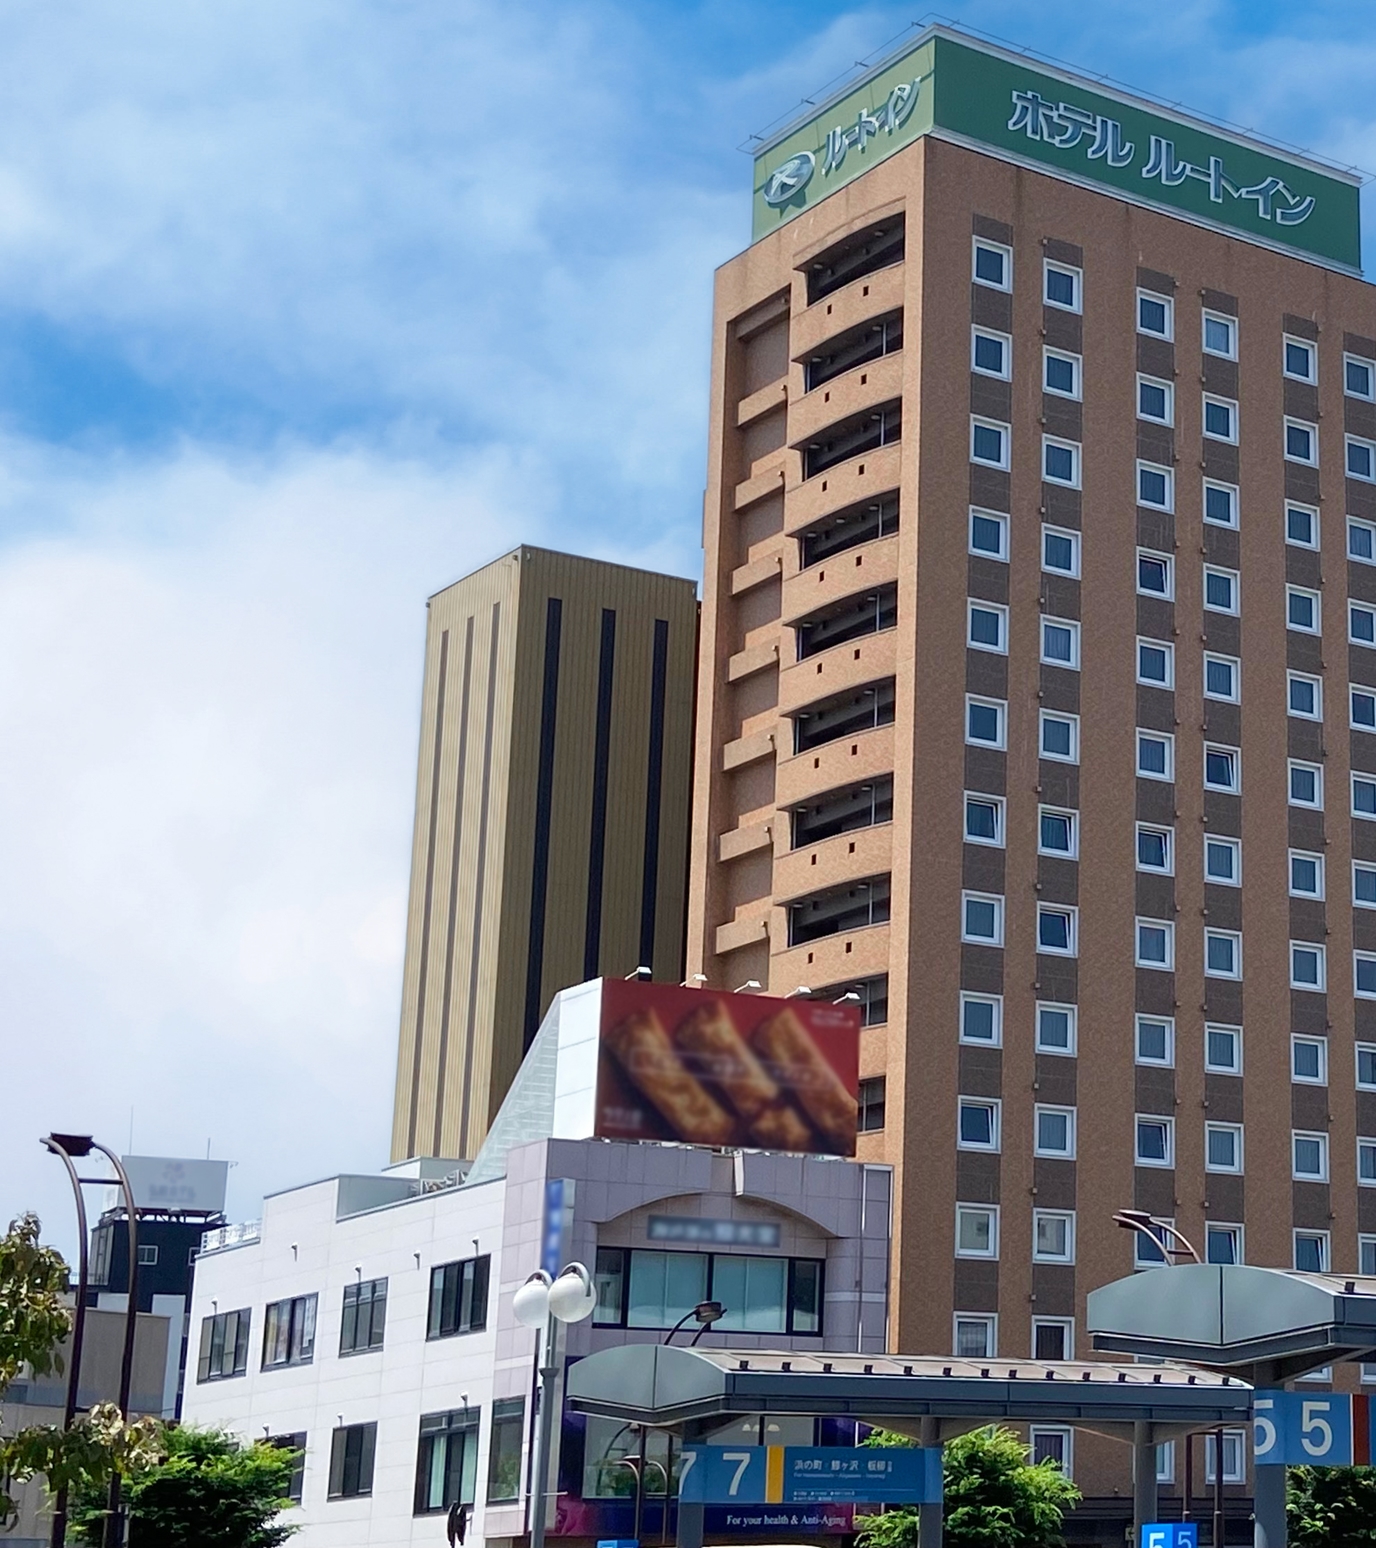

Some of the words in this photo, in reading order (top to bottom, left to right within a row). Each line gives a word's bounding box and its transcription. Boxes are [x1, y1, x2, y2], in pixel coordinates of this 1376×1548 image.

[822, 76, 922, 175] ルートイン
[1008, 90, 1134, 167] ホテル
[1142, 135, 1316, 226] ルートイン
[1301, 1401, 1333, 1457] 5
[679, 1451, 698, 1496] 7
[722, 1453, 751, 1496] 7
[726, 1515, 742, 1525] For
[743, 1517, 763, 1527] your
[764, 1514, 789, 1525] health
[801, 1514, 846, 1527] Anti-Aging
